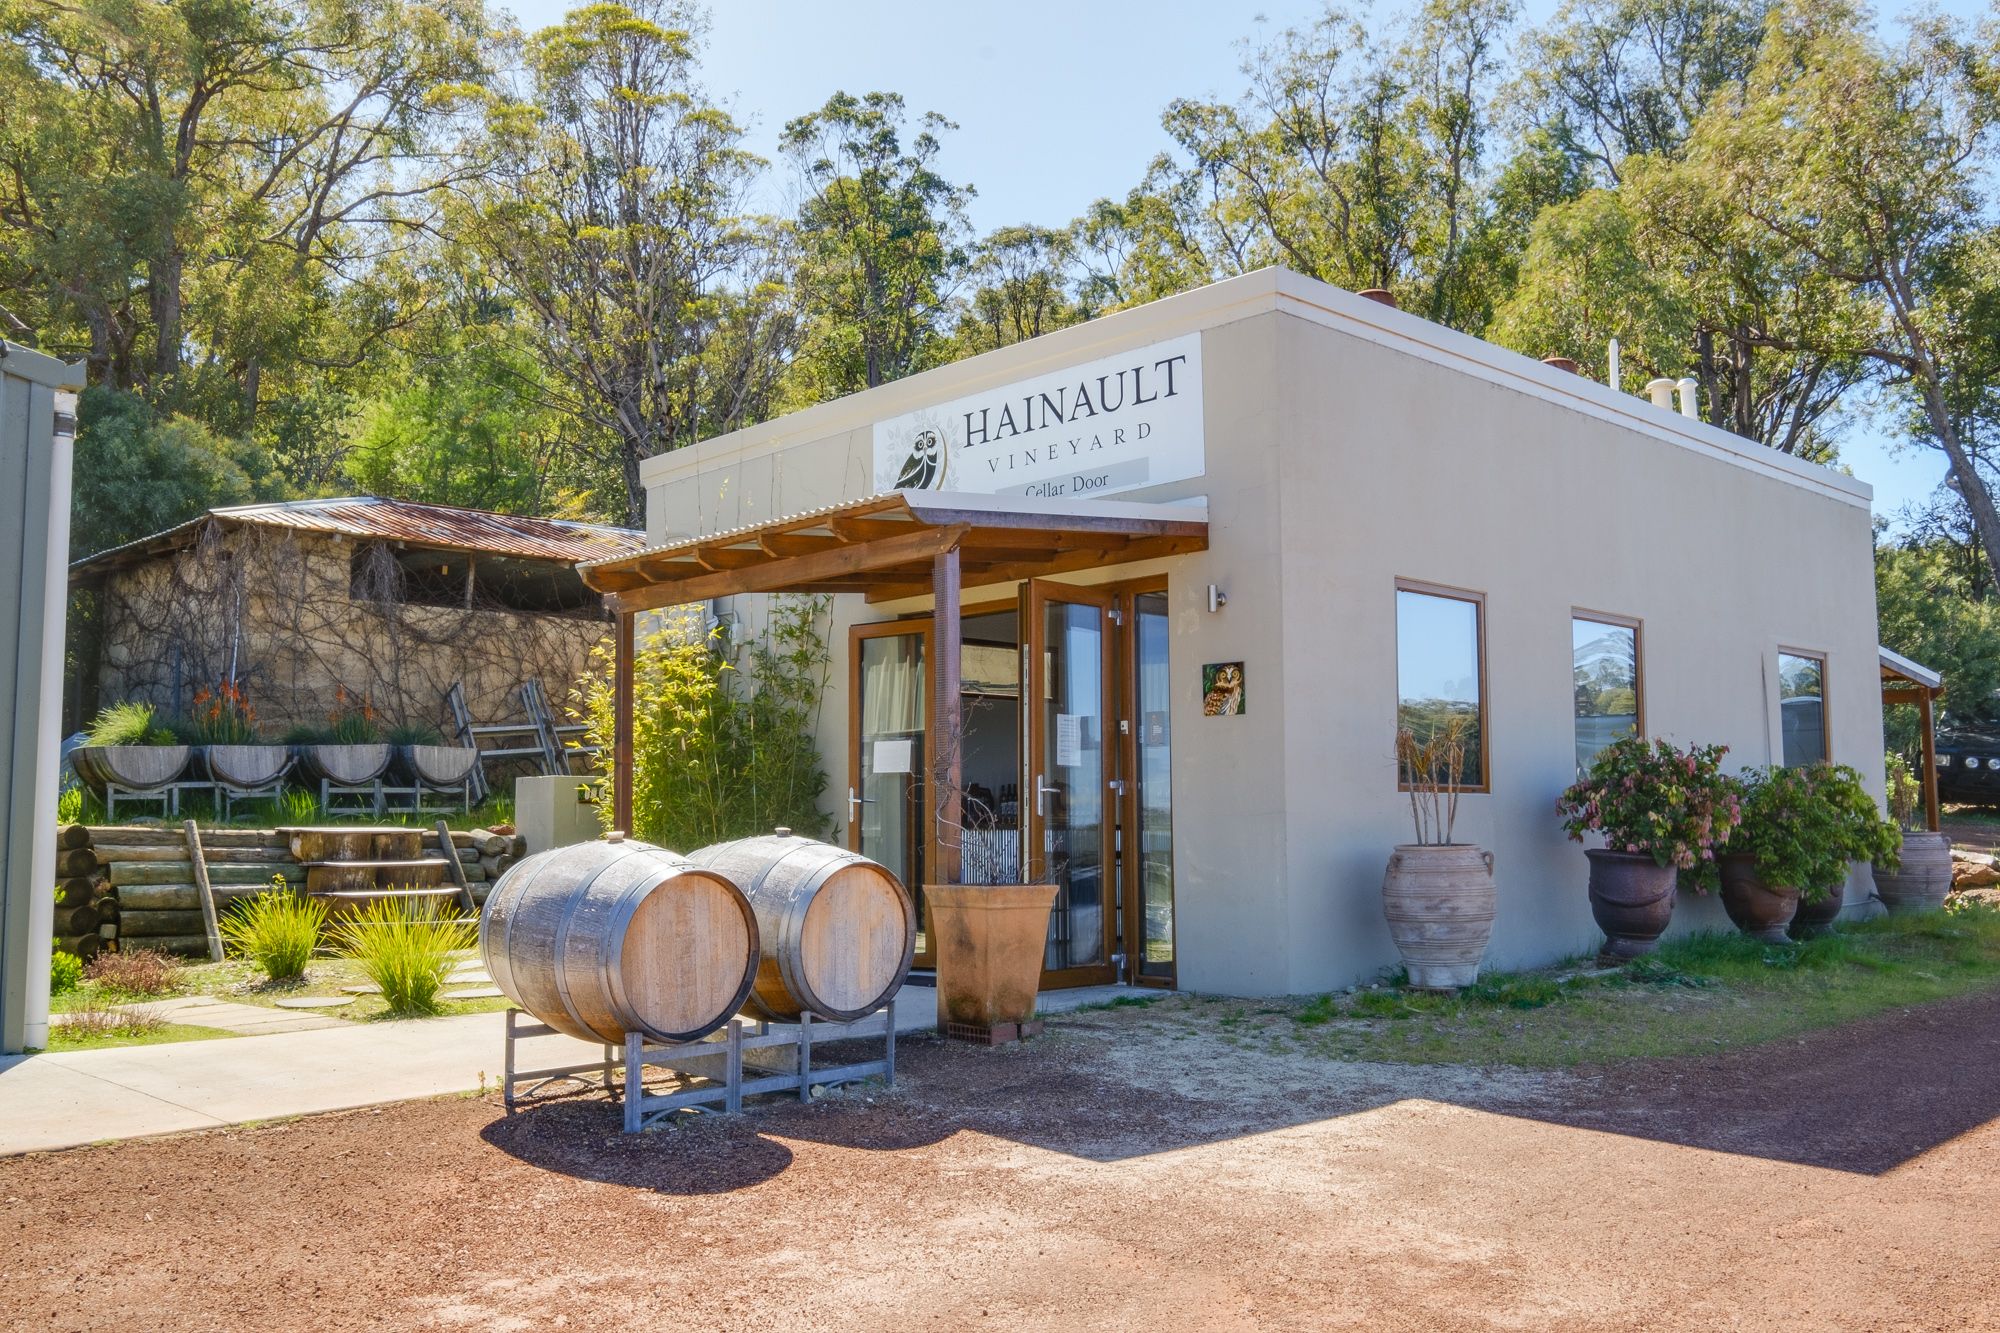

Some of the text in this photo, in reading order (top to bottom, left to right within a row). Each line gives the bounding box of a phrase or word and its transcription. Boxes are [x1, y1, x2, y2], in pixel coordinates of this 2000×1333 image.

[963, 354, 1186, 449] HAINAULT
[988, 421, 1152, 473] VINEYARD
[1072, 474, 1109, 492] Door
